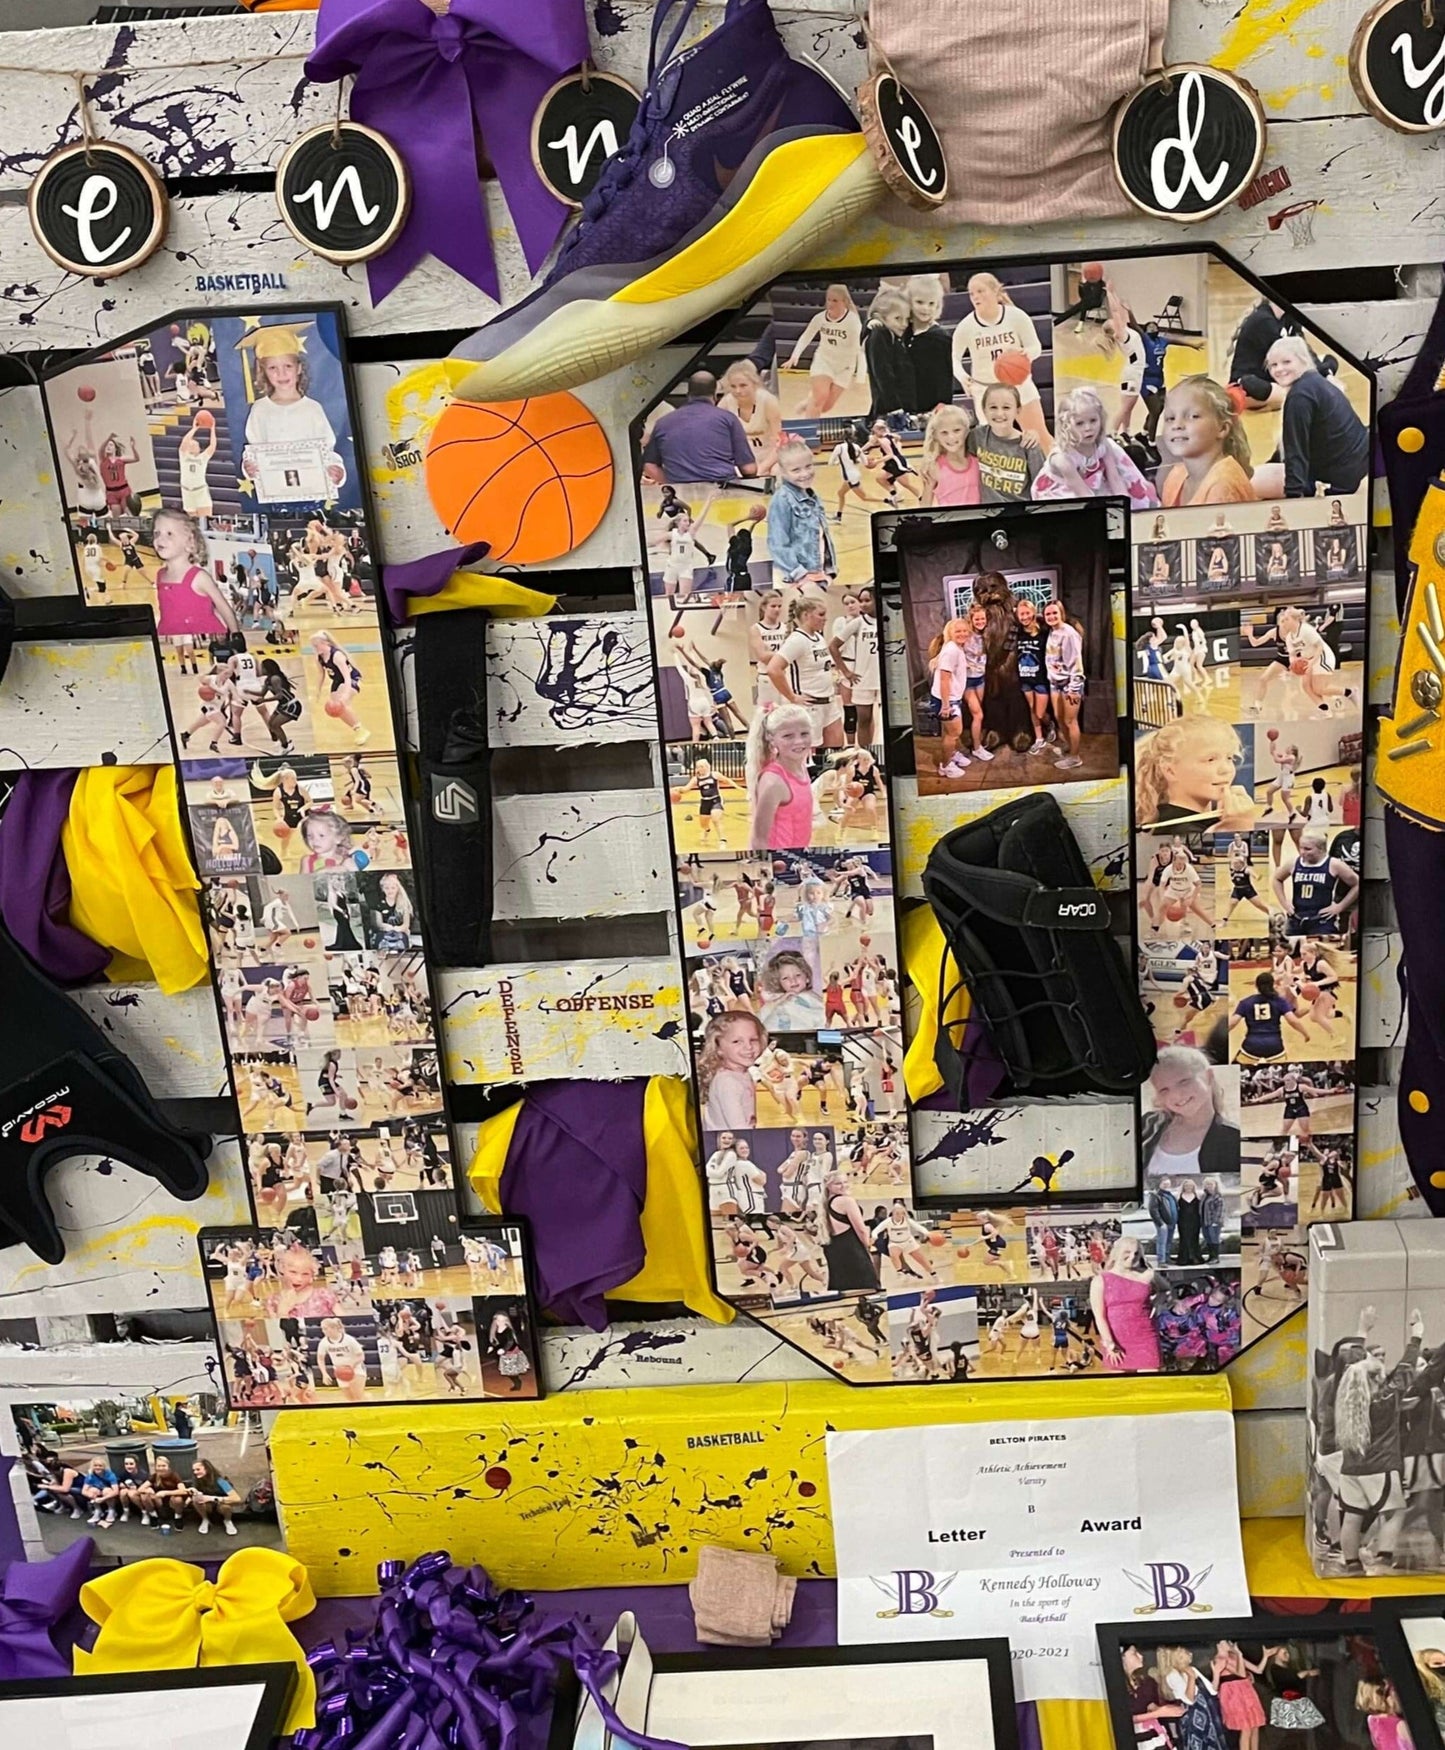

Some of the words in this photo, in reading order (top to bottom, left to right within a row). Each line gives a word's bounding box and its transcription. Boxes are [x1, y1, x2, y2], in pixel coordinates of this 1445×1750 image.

[683, 105, 702, 120] QUAD
[1150, 71, 1229, 210] d
[196, 273, 286, 292] BASKETBALL
[975, 331, 1015, 349] PIRATES
[396, 450, 422, 468] SHOT
[980, 472, 1024, 495] IGERS
[241, 658, 254, 669] 33
[1294, 872, 1326, 884] BELTON
[1301, 884, 1313, 899] 10
[556, 994, 655, 1012] OFFENSE
[1254, 1002, 1271, 1020] 13
[498, 981, 524, 1075] DEFENSE
[635, 1354, 683, 1364] Rebound
[687, 1431, 765, 1449] BASKETBALL
[990, 1436, 1026, 1445] BELTON
[1028, 1434, 1067, 1442] PIRATES
[976, 1463, 1011, 1475] Athletic
[1012, 1461, 1067, 1473] Achievement
[1028, 1505, 1036, 1514] B
[928, 1529, 987, 1543] Letter
[1080, 1516, 1142, 1533] Award
[1009, 1546, 1055, 1558] Presented
[1056, 1548, 1065, 1556] to
[979, 1574, 1036, 1593] Kennedy
[1038, 1573, 1101, 1591] Holloway
[1010, 1599, 1020, 1608] In
[1022, 1597, 1036, 1607] the
[1037, 1598, 1059, 1609] sport
[1061, 1596, 1072, 1608] of
[1019, 1613, 1068, 1623] Basketball
[1008, 1647, 1070, 1660] 020-2021
